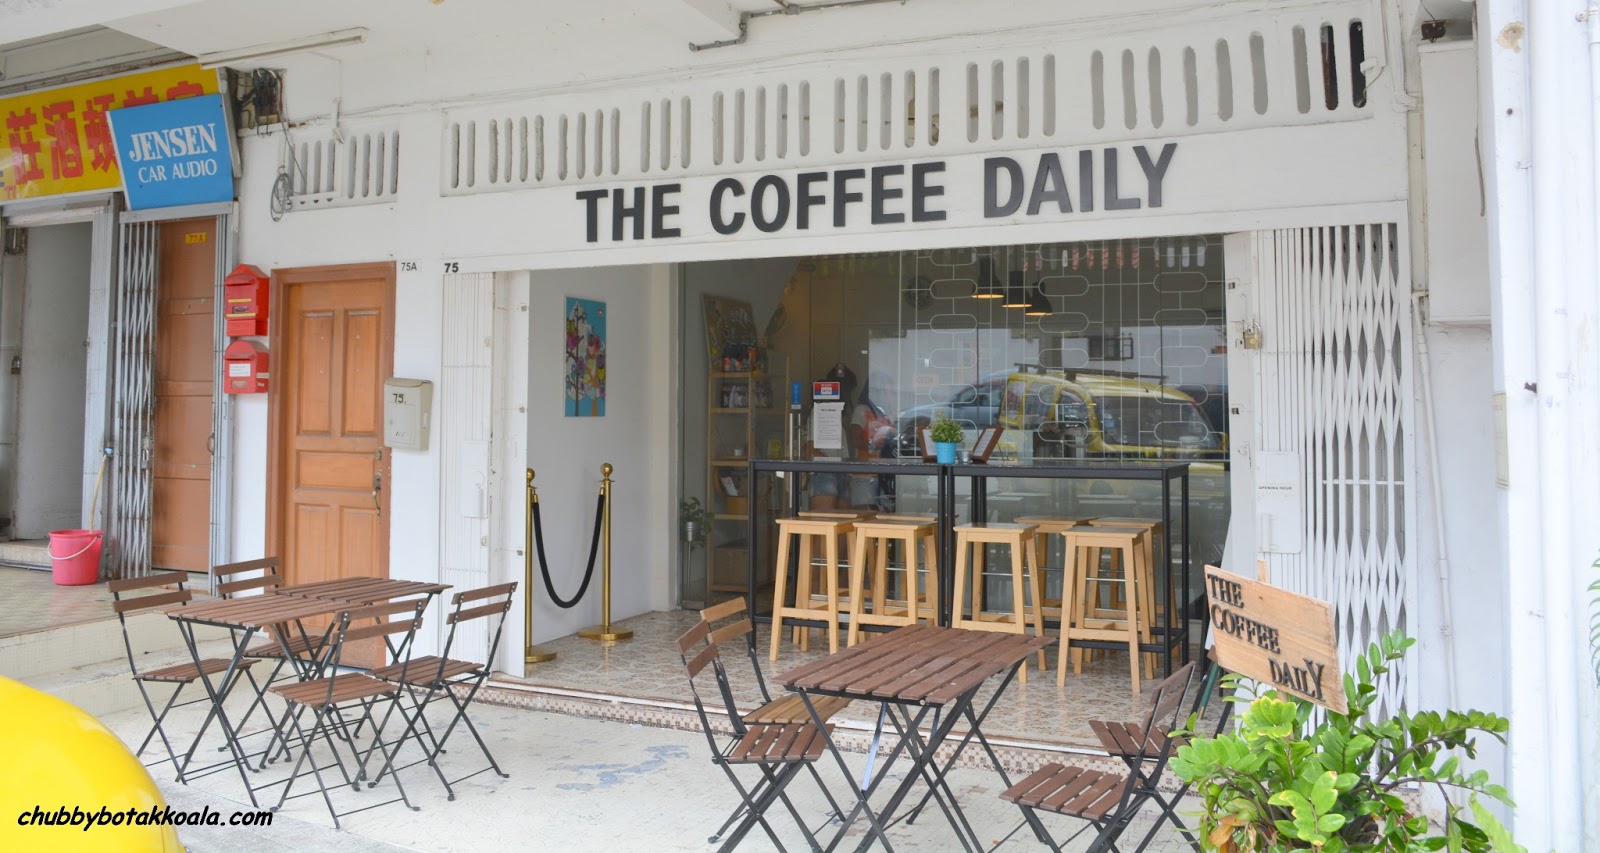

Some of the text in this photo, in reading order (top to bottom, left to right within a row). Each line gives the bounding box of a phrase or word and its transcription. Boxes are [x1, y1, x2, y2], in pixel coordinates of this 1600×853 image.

[129, 122, 218, 162] JENSEN
[138, 158, 218, 184] CAR AUDIO
[575, 142, 1178, 243] THE COFFEE DAILY
[400, 262, 418, 272] 75A
[443, 262, 460, 273] 75
[1207, 573, 1244, 609] THE
[1210, 604, 1281, 654] COFFEE
[1268, 657, 1325, 701] DAILY
